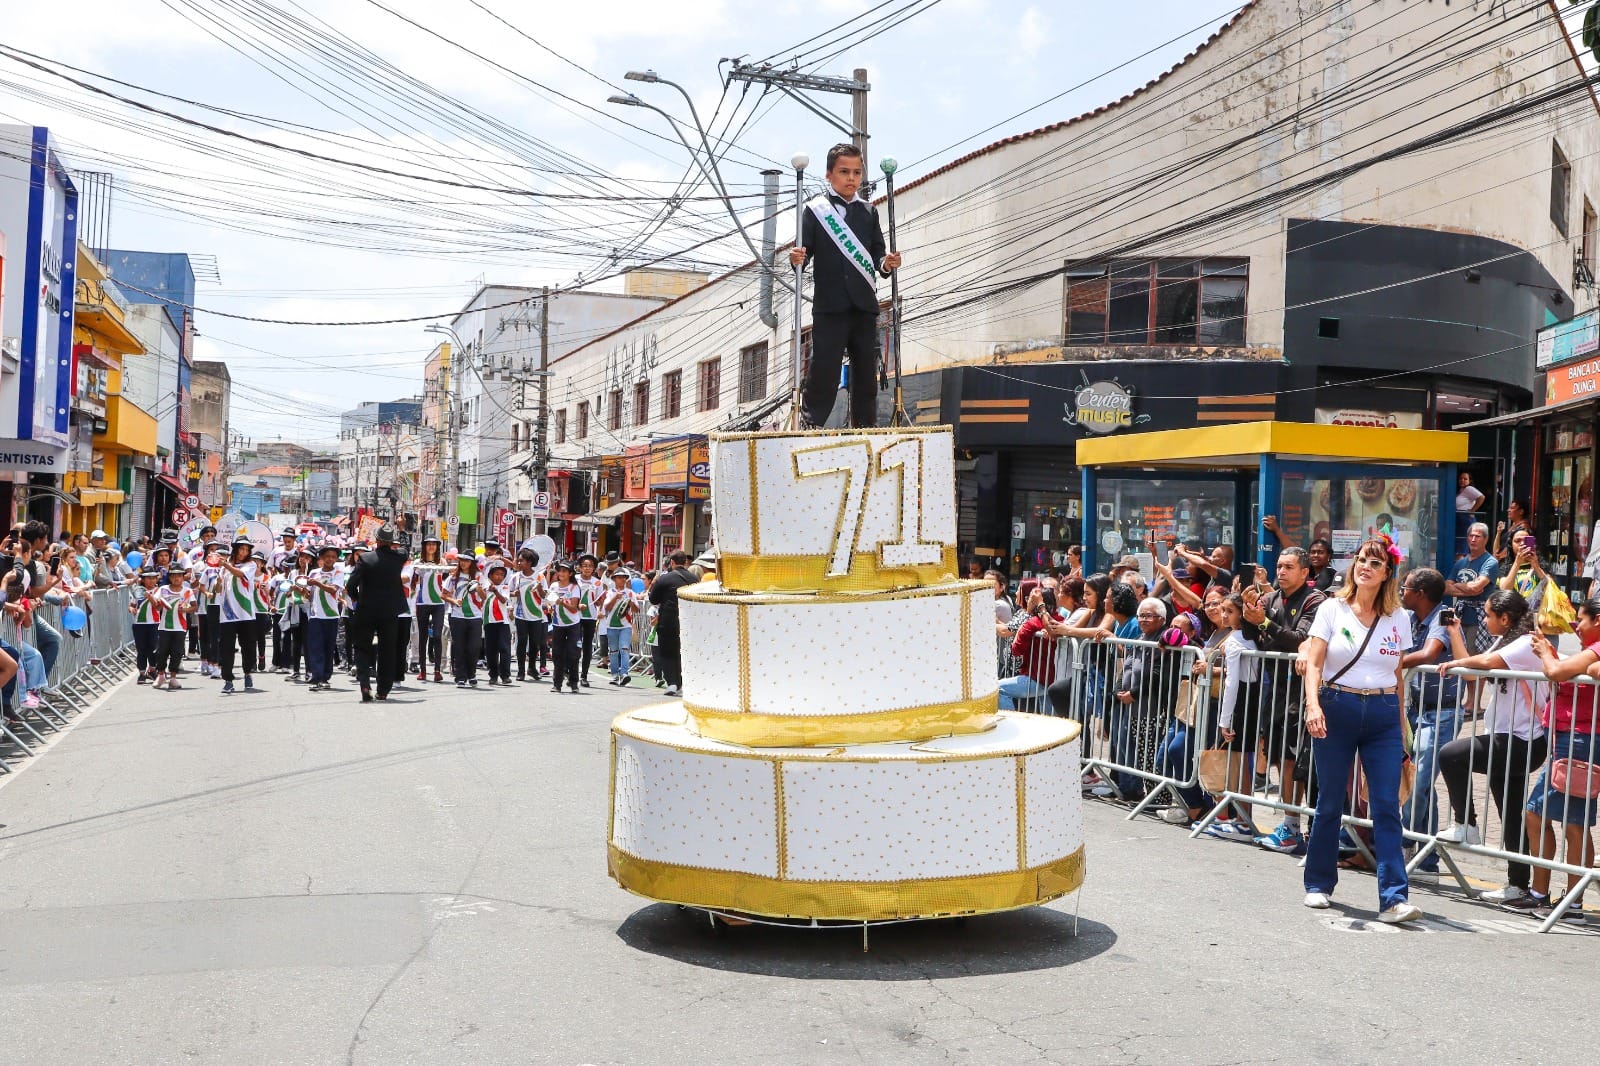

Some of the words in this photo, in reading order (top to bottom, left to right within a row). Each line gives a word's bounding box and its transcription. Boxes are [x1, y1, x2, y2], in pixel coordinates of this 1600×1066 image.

[825, 214, 846, 235] JOSÉ
[844, 240, 857, 254] DE
[1568, 362, 1591, 380] BANCA
[1572, 379, 1596, 394] DUNGA
[1077, 387, 1130, 409] Center
[1077, 408, 1132, 426] music
[187, 497, 198, 505] 30
[791, 438, 943, 580] 71
[504, 514, 514, 522] 30
